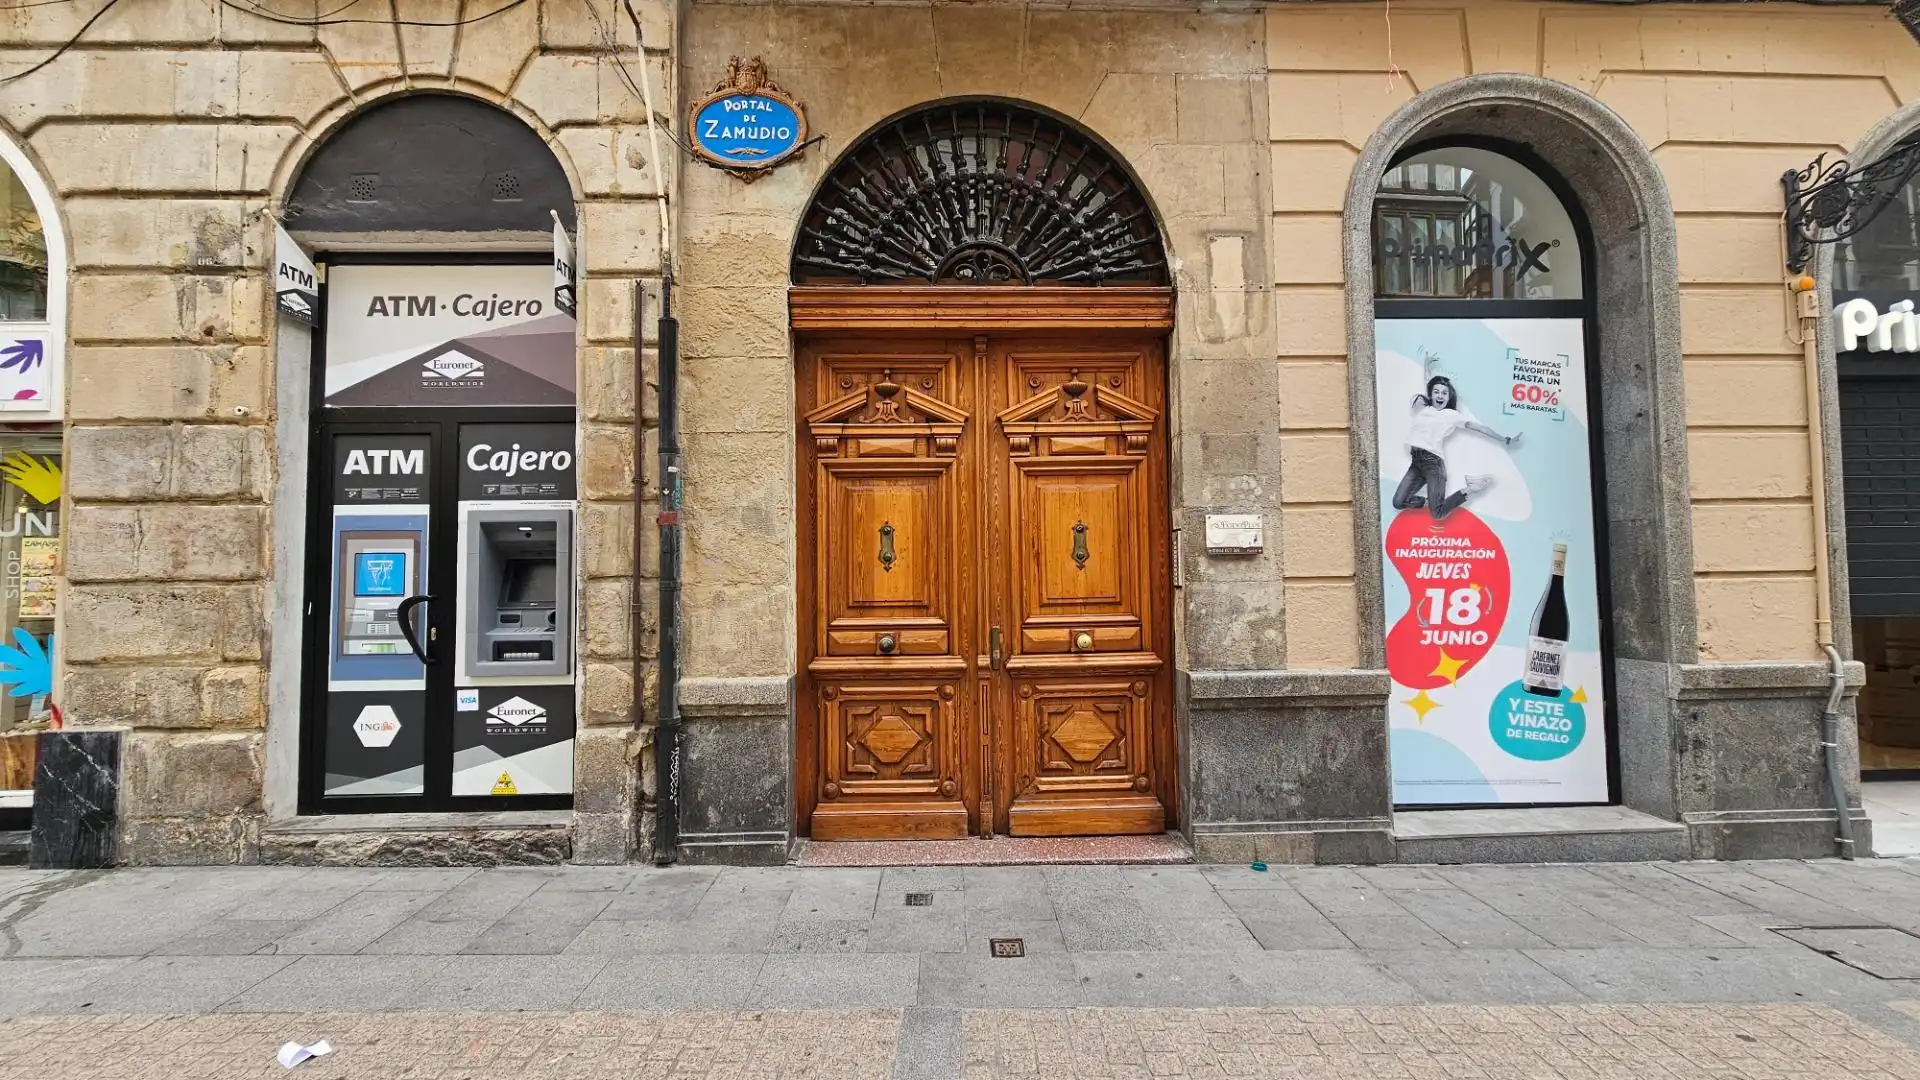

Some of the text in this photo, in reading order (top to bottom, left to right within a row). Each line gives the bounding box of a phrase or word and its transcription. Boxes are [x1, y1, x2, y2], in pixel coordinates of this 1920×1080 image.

[724, 100, 773, 112] PORTAL
[743, 114, 756, 122] DE
[704, 119, 790, 139] ZAMUDIO
[279, 262, 313, 289] ATM
[366, 295, 436, 317] ATM
[452, 293, 543, 321] Cajero
[433, 359, 474, 370] Euronet
[1513, 365, 1560, 376] FAVORITAS
[1530, 360, 1561, 368] MARCAS
[1513, 373, 1560, 385] HASTA UN
[342, 449, 424, 475] ATM
[467, 443, 571, 477] Cajero
[1411, 536, 1472, 547] PRÓXIMA
[1395, 547, 1496, 559] INAUGURACIÓN
[7, 550, 20, 599] SHOP
[1416, 562, 1472, 579] JUEVES
[1425, 588, 1481, 625] 18
[1420, 630, 1488, 645] JUNIO
[1532, 650, 1560, 665] CABERNET
[497, 706, 536, 716] Euronet
[1509, 698, 1564, 716] Y ESTE
[360, 723, 380, 731] ING
[1508, 712, 1572, 731] VINAZO
[1507, 728, 1569, 743] DE REGALO
